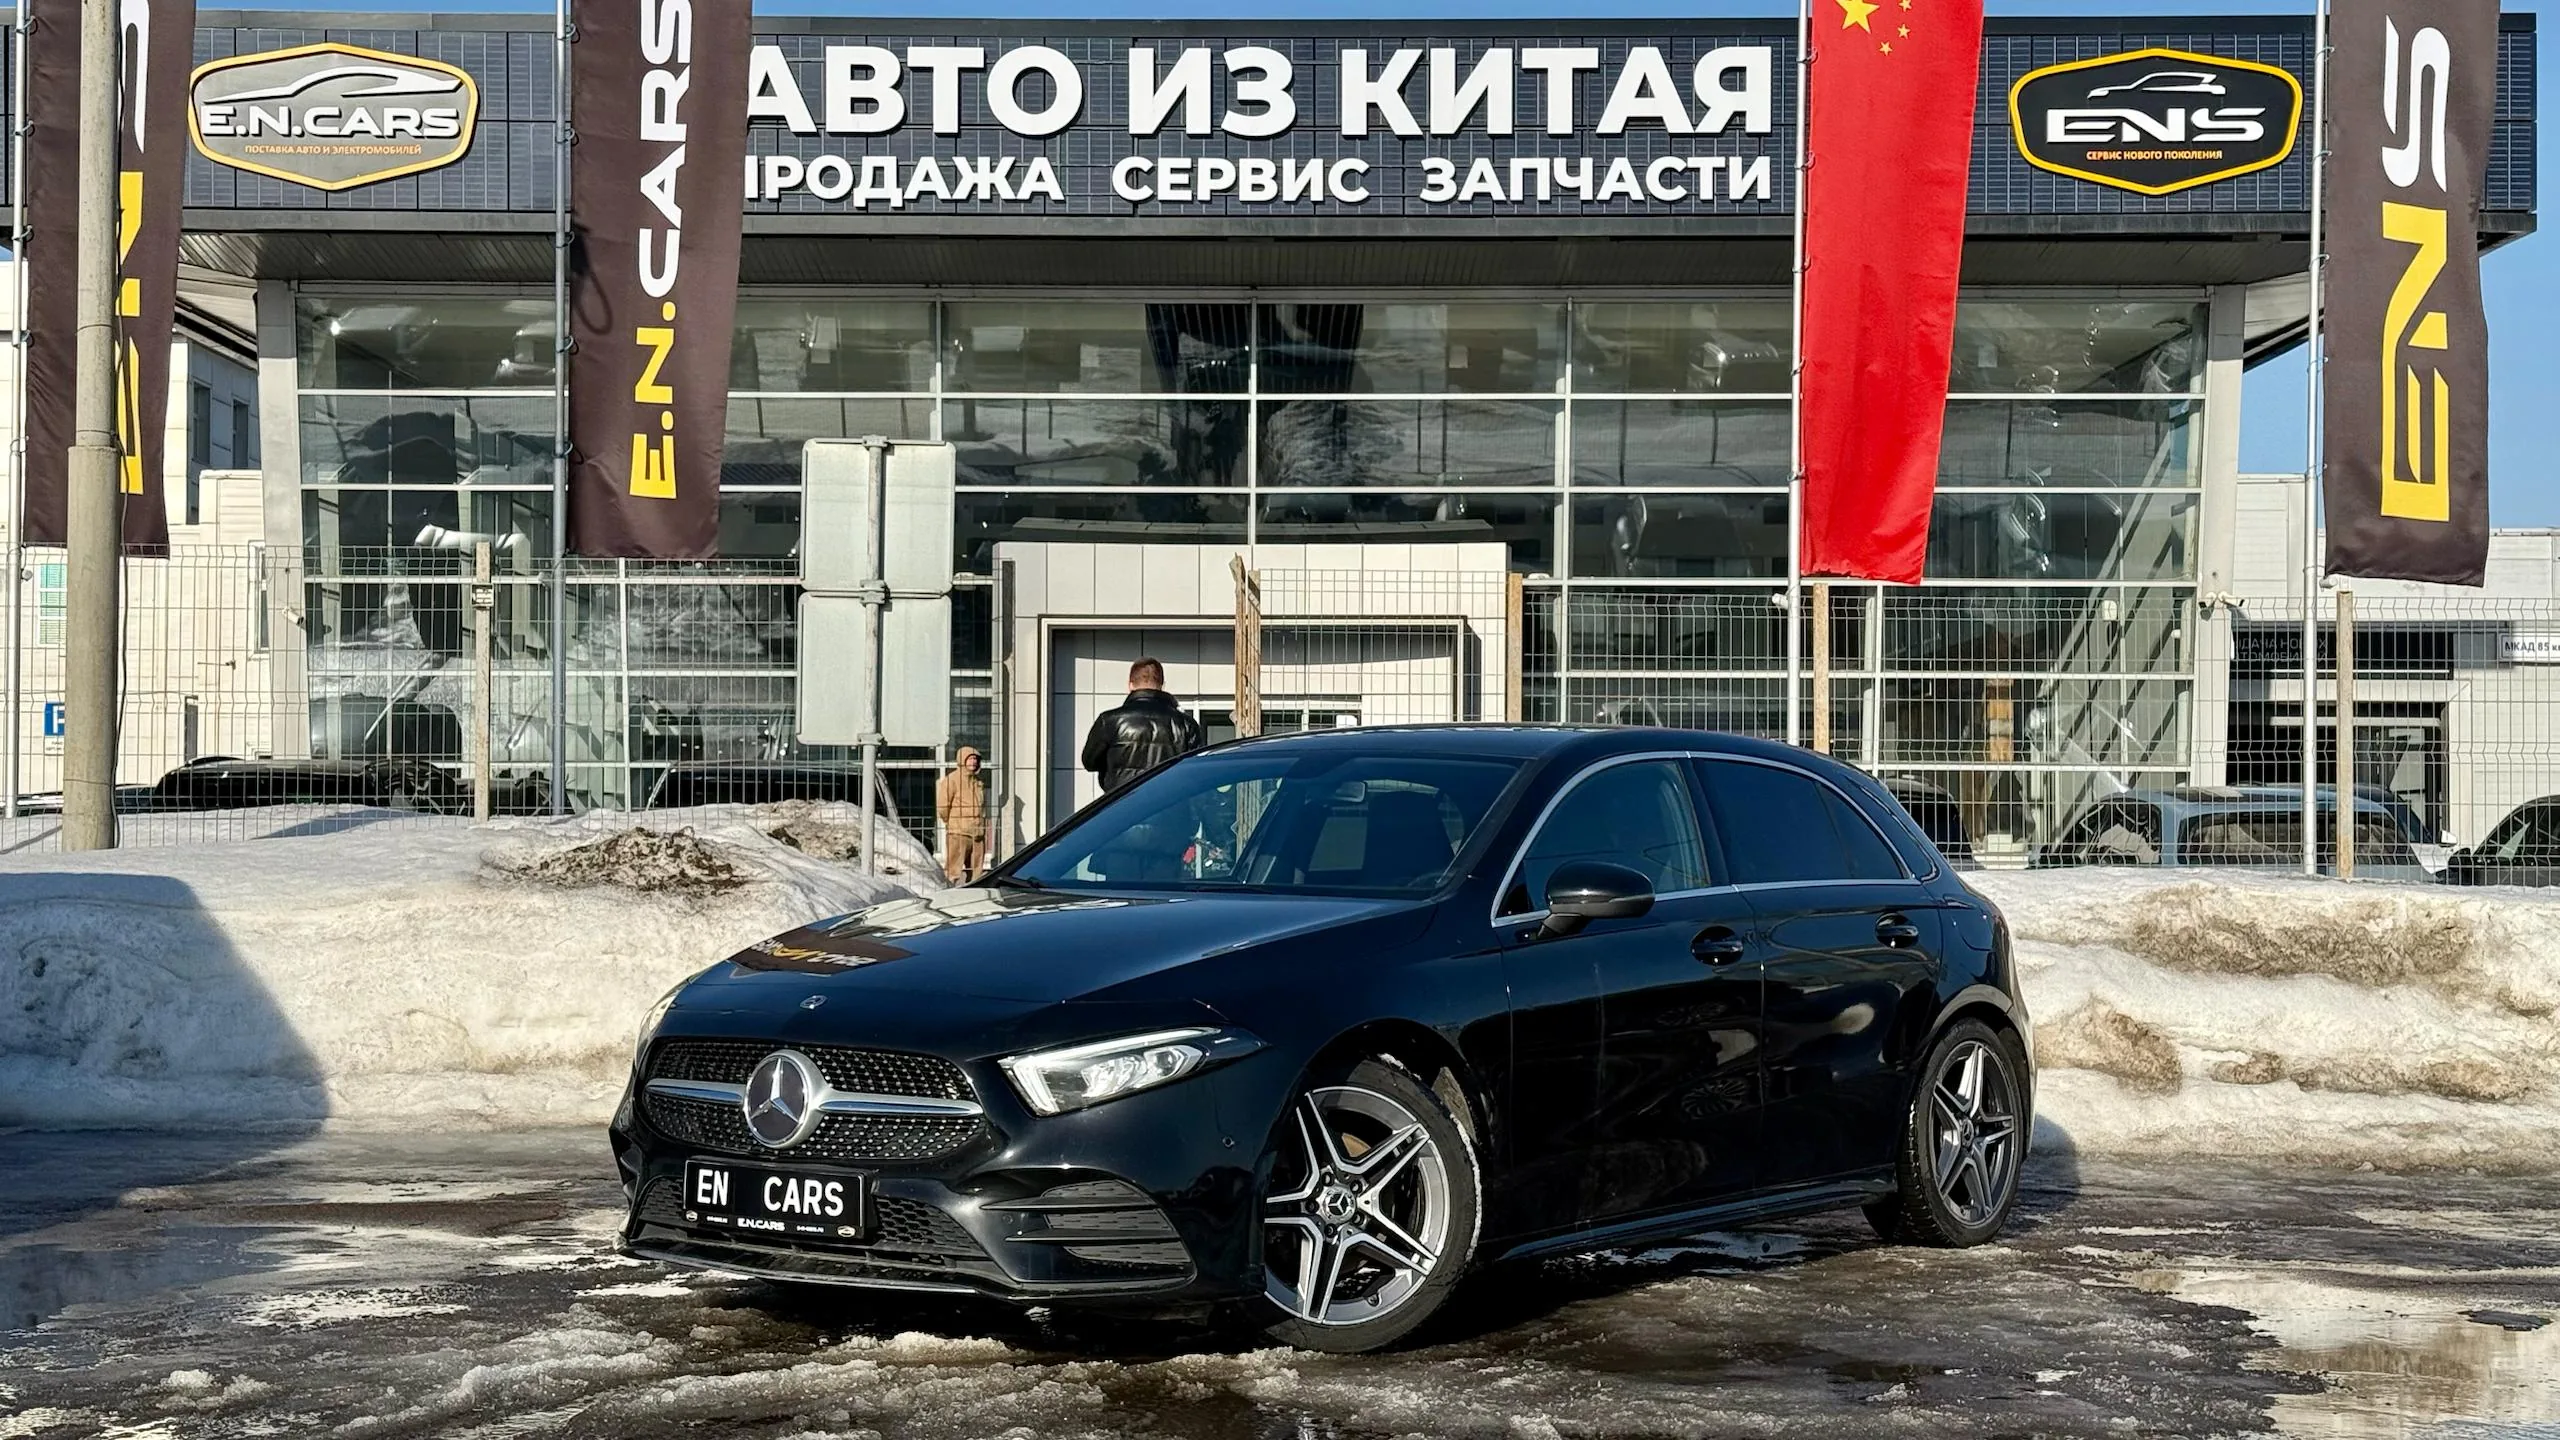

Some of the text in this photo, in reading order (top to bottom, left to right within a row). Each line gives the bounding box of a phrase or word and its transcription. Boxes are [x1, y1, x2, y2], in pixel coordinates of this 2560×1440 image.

[747, 45, 1772, 137] АВТО ИЗ КИТАЯ
[201, 105, 460, 137] E.N.CARS
[2047, 108, 2266, 142] ENS
[245, 144, 422, 155] ПОСТАВКА АВТО И ЭЛЕКТРОМОБИЛЕЙ
[2086, 150, 2223, 160] СЕРВИС НОВОГО ПОКОЛЕНИЯ
[1112, 157, 1370, 202] СЕРВИС
[1420, 156, 1772, 202] ЗАПЧАСТИ
[630, 0, 693, 499] E.N.CARS
[2380, 14, 2450, 522] ENS
[2505, 641, 2535, 652] МКАД
[2538, 642, 2550, 651] 85
[697, 1168, 844, 1217] EN CARS
